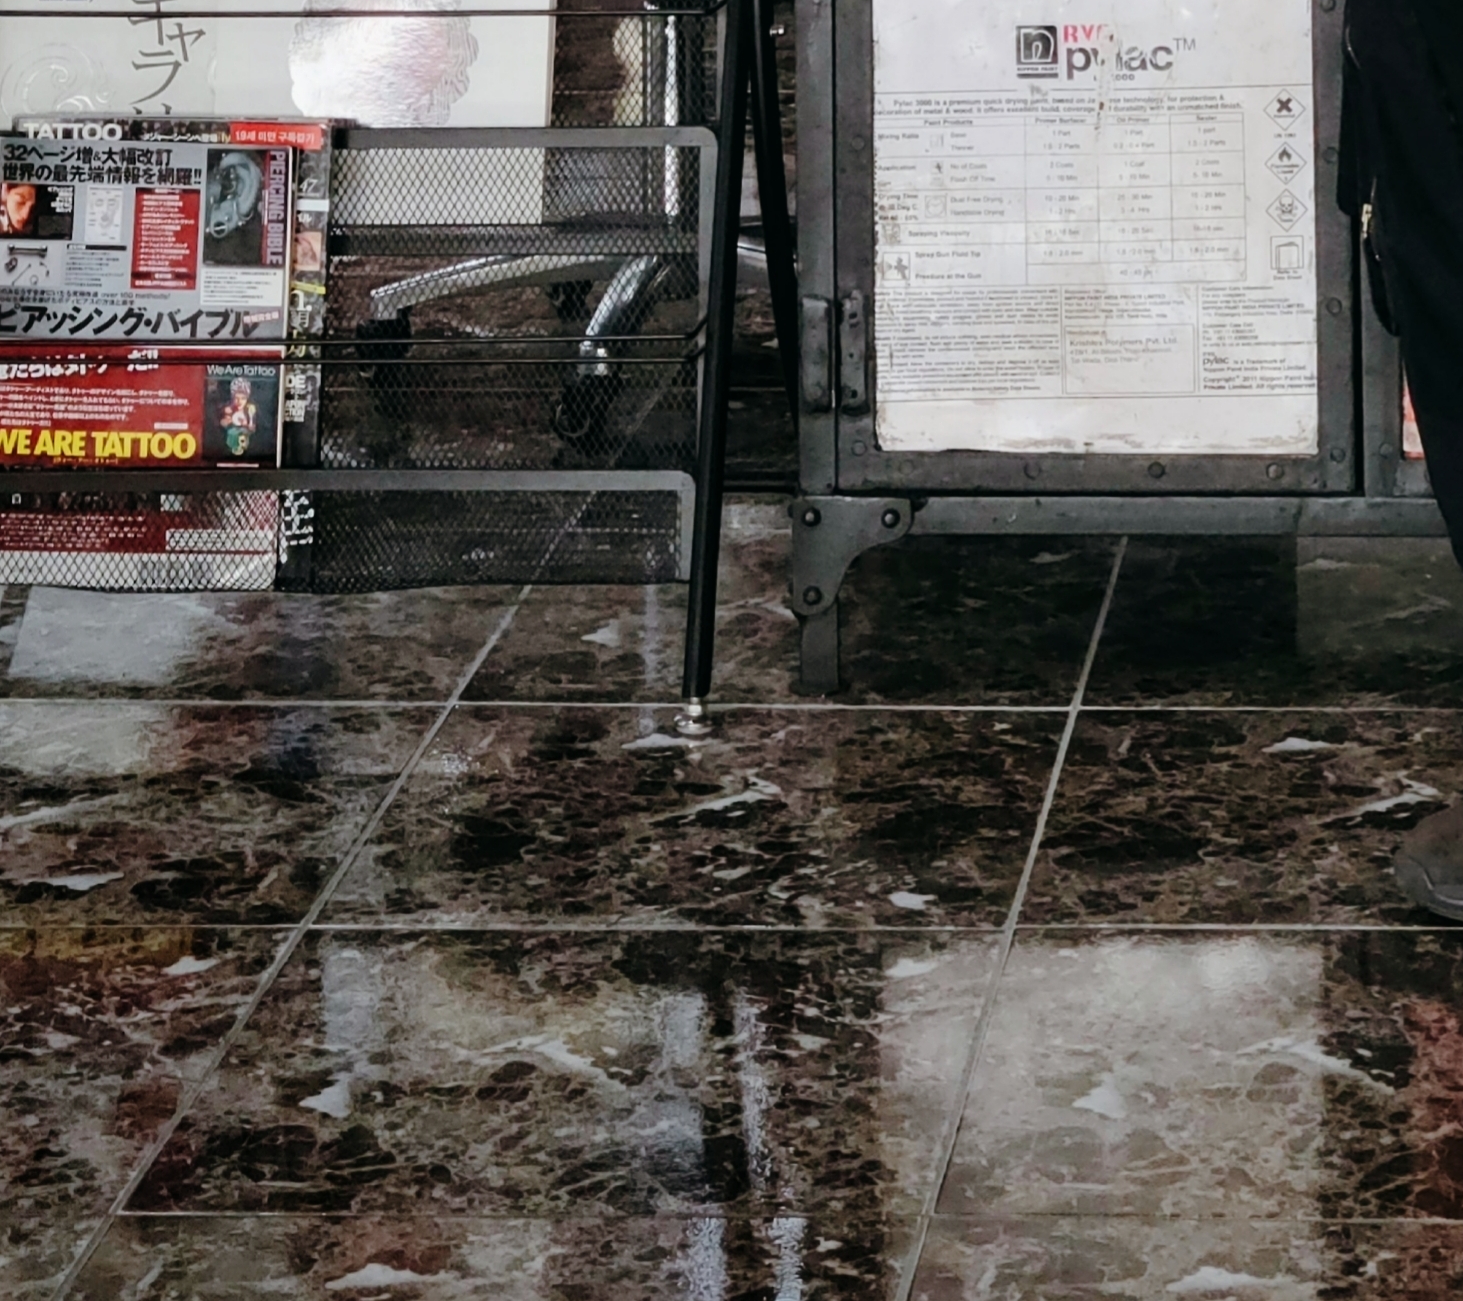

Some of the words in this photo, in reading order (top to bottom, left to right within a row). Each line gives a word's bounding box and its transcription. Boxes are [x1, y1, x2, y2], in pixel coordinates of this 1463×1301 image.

[1063, 23, 1110, 43] RY
[893, 99, 914, 108] Pylac
[915, 99, 933, 107] 3000
[950, 99, 982, 108] premium
[983, 98, 1003, 107] quick
[1004, 97, 1029, 107] drying
[1179, 95, 1218, 104] protection
[914, 107, 922, 115] of
[923, 107, 943, 115] metal
[1006, 105, 1038, 114] excellent
[1113, 103, 1148, 113] durability
[943, 118, 974, 126] Products
[23, 123, 123, 141] TATTOO
[268, 150, 287, 221] PIERCING
[266, 223, 285, 265] BIBLE
[0, 428, 33, 455] WE
[33, 429, 87, 457] ARE
[90, 430, 197, 459] TATTOO
